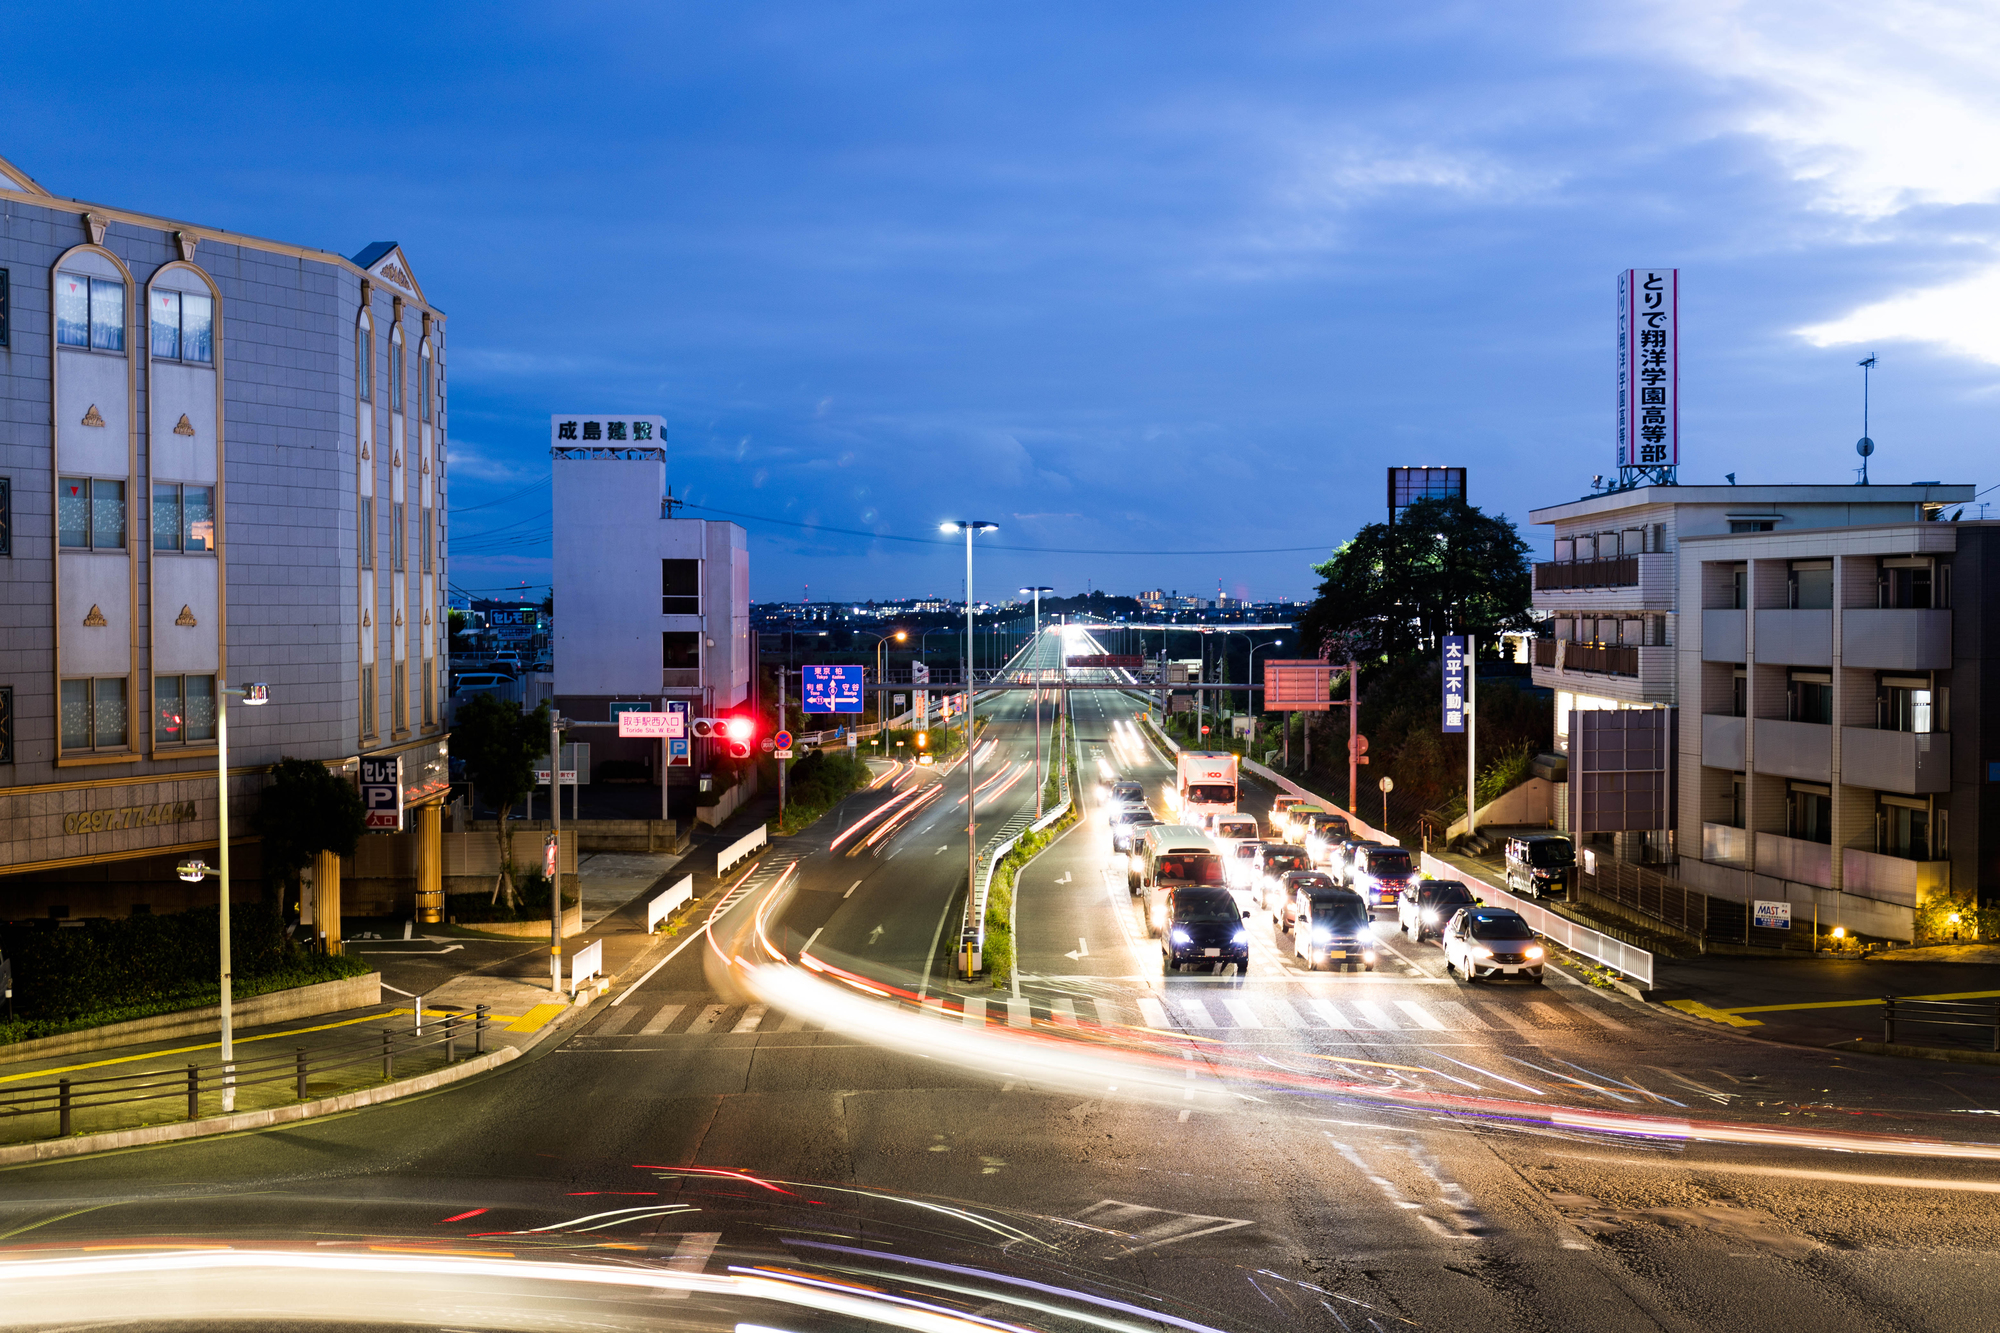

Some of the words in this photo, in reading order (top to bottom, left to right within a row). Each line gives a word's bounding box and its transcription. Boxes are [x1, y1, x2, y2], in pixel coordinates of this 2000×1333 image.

[1641, 273, 1667, 463] とりで翔洋学園高等部
[558, 421, 652, 440] 成島建設
[493, 612, 523, 624] セレモ
[1446, 643, 1461, 726] 太平不動産
[623, 717, 679, 726] 取手駅西入口
[673, 742, 685, 753] P
[363, 761, 396, 782] セレモ
[369, 788, 393, 808] P
[372, 816, 393, 825] 入口
[1757, 905, 1779, 915] MAST
